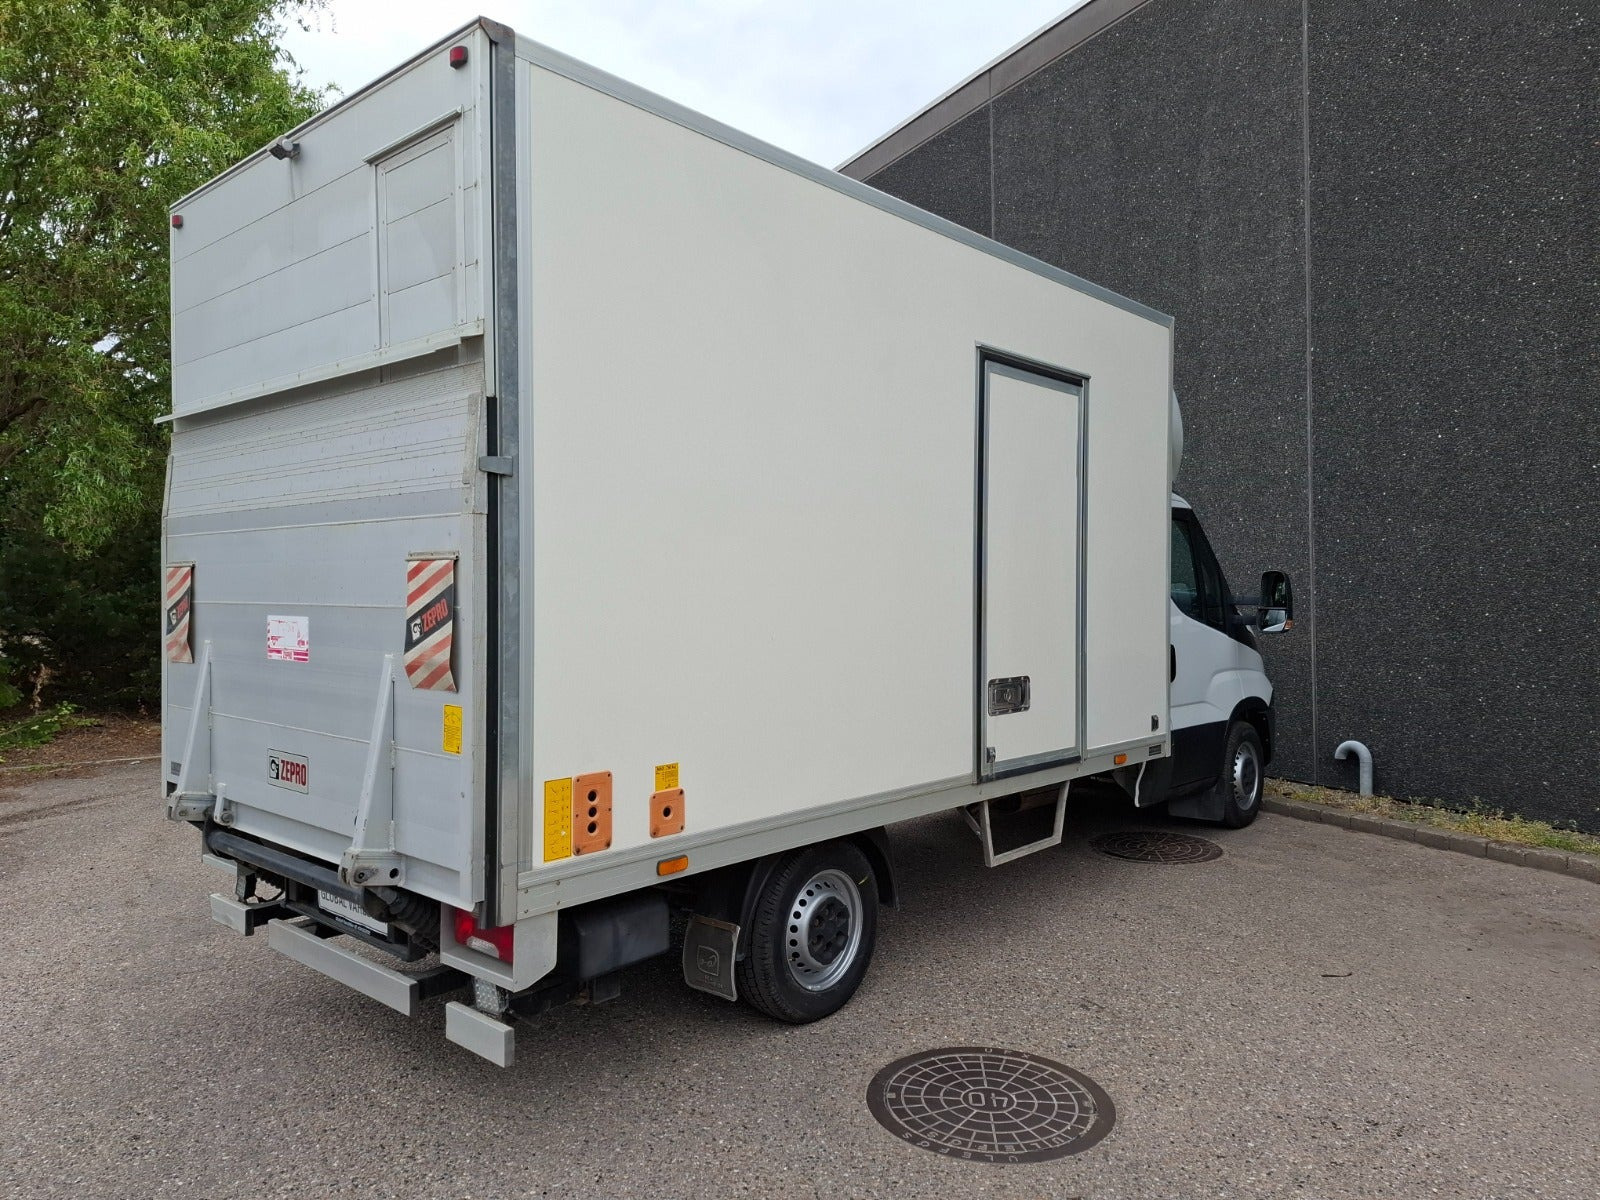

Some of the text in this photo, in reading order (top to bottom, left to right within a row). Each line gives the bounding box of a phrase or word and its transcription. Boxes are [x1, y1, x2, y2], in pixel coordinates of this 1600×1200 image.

[421, 598, 449, 633] ZEPRO
[280, 759, 307, 787] ZEPRO
[968, 1092, 1009, 1108] 40
